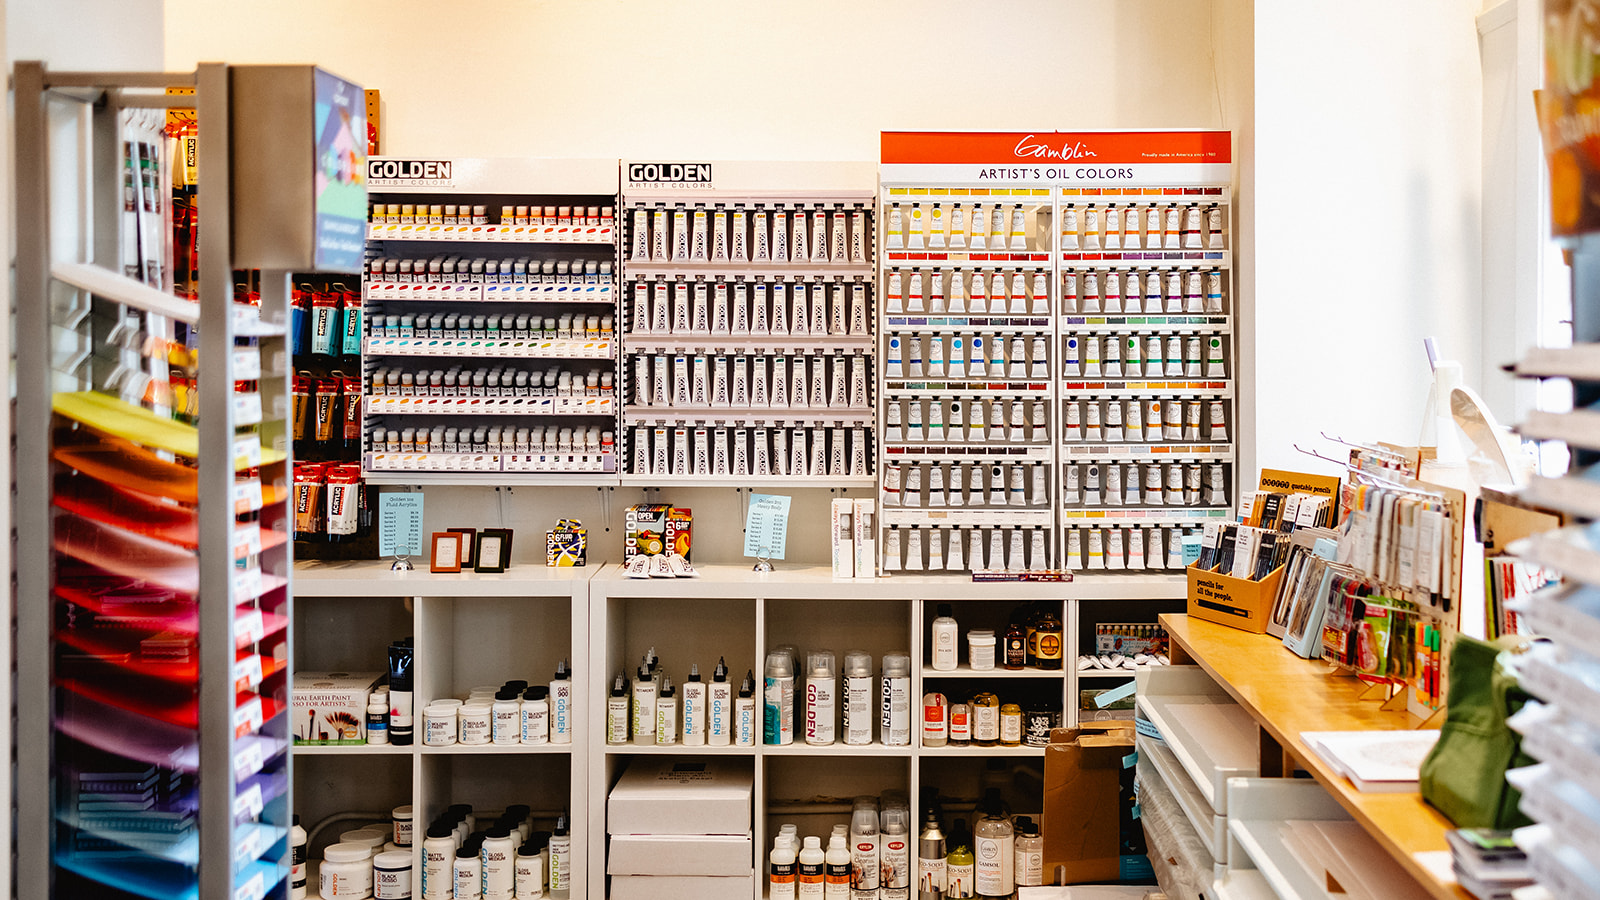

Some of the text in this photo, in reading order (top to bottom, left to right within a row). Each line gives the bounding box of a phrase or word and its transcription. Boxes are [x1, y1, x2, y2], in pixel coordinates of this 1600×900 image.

[1014, 134, 1098, 161] Gamblin
[370, 162, 450, 178] GOLDEN
[630, 164, 710, 181] GOLDEN
[979, 168, 1134, 179] ARTIST'S OIL COLORS
[320, 396, 328, 422] ACRYLIC
[299, 486, 308, 512] ACRYLIC
[332, 488, 341, 514] ACRYLIC
[676, 522, 681, 530] 6
[666, 522, 675, 557] GOLDE
[1197, 580, 1224, 590] pencils for
[1214, 592, 1233, 602] people.
[807, 684, 816, 738] GOLDEN
[882, 678, 891, 727] GOLDEN
